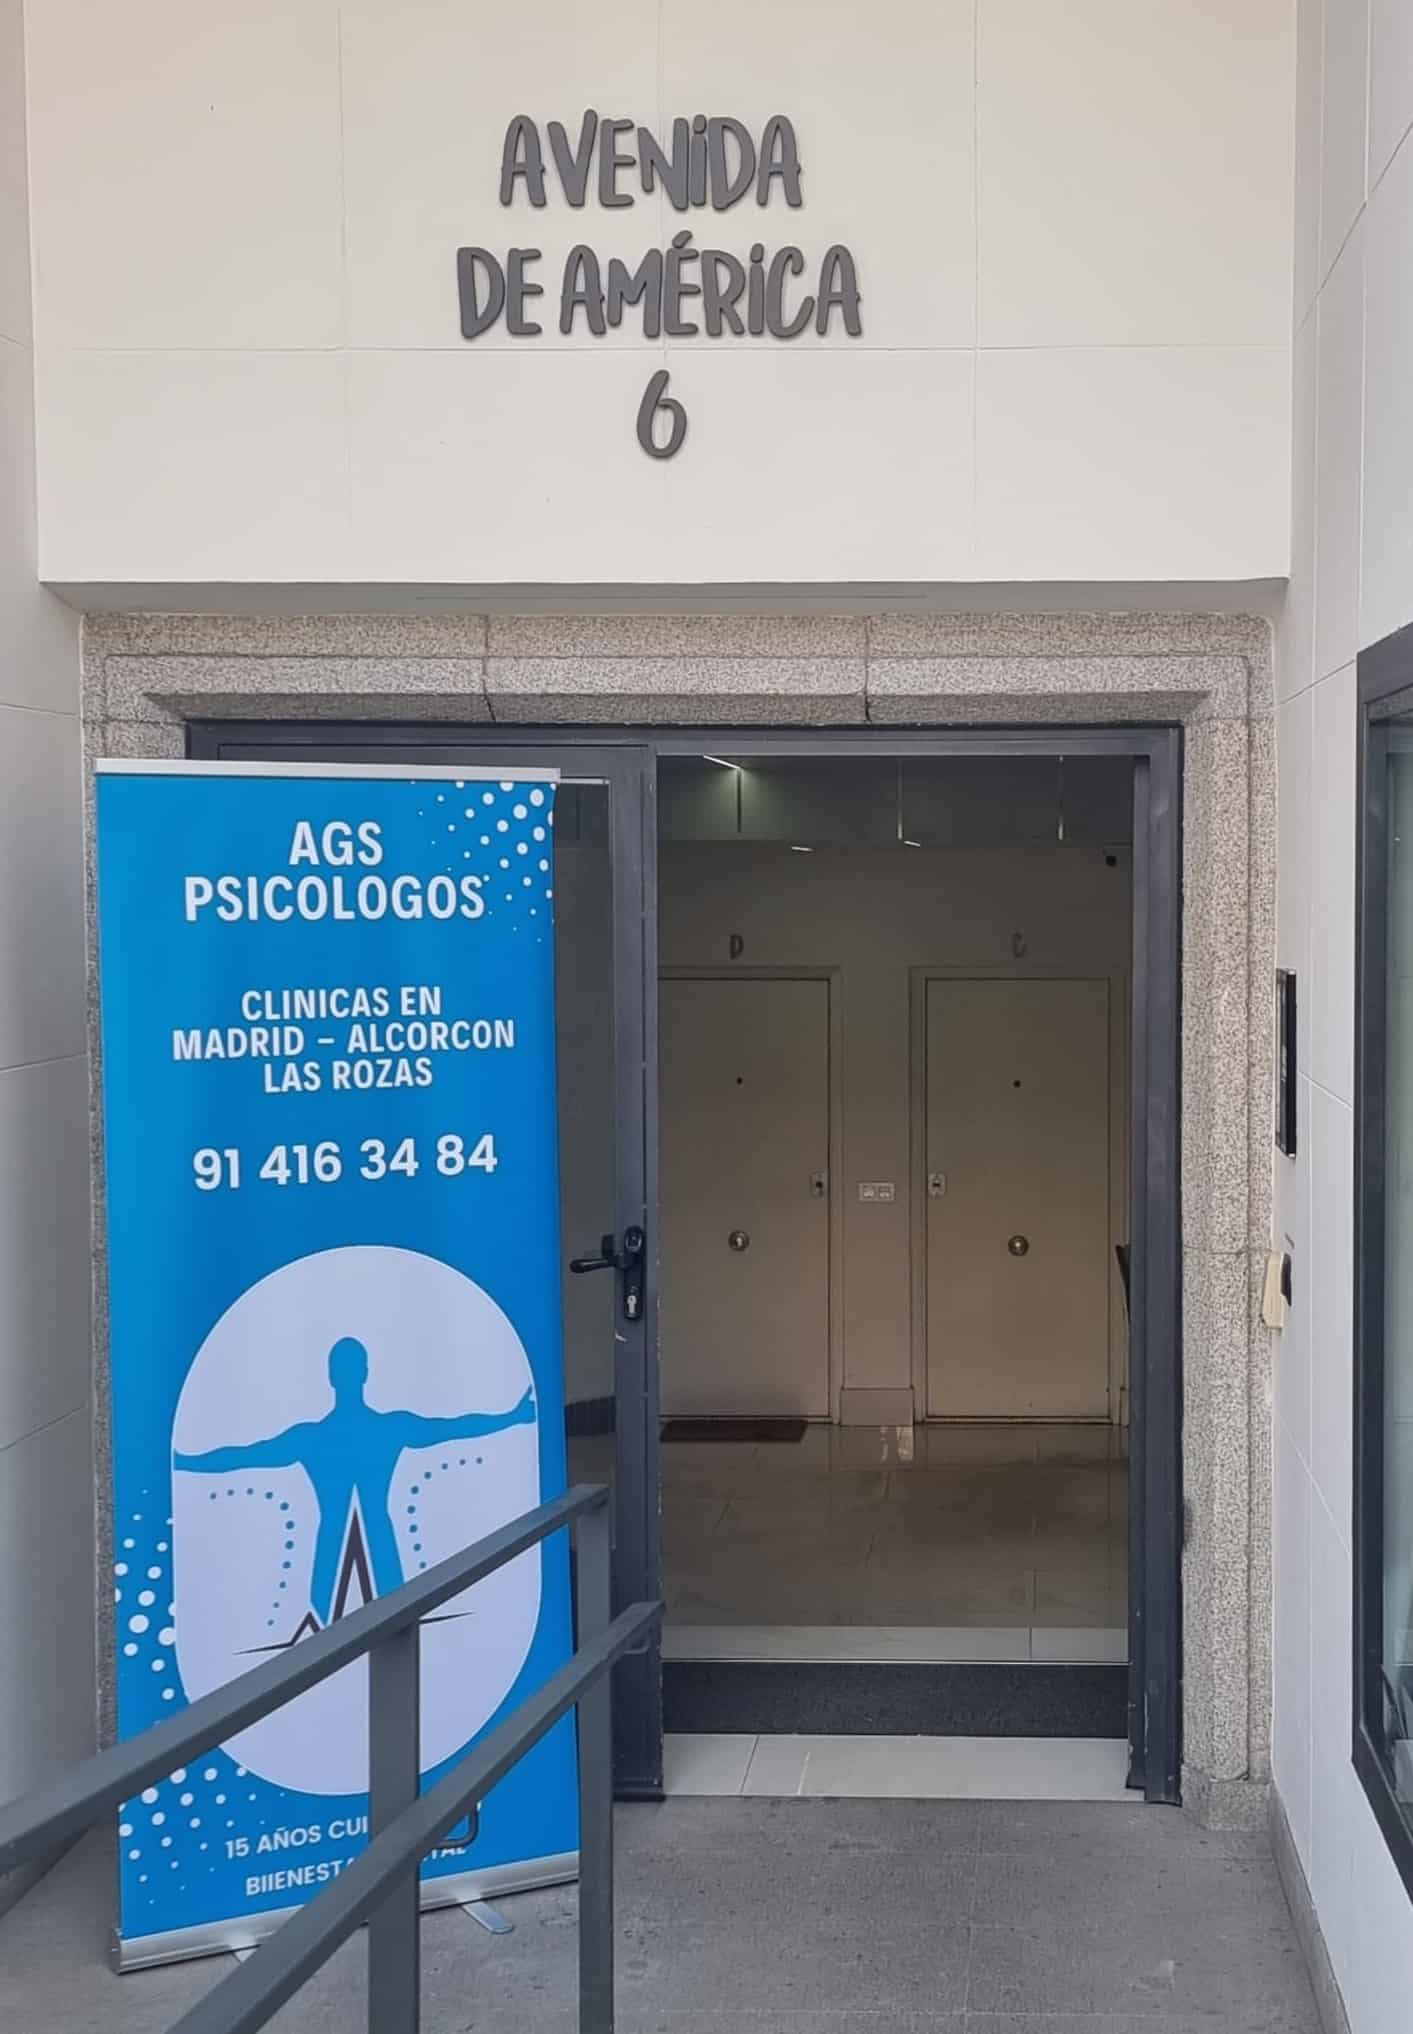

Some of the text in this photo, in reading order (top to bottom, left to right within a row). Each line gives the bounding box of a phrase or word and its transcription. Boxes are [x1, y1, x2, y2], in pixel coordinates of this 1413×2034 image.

[456, 246, 544, 341] DE
[636, 369, 688, 460] 6
[289, 821, 383, 866] AGS
[185, 875, 485, 922] PSICOLOGOS
[241, 986, 441, 1021] CLINICAS EN
[172, 1026, 305, 1061] MADRID
[347, 1019, 515, 1054] ALCORCON
[264, 1057, 433, 1093] LAS ROZAS
[193, 1134, 498, 1190] 91 416 34 84
[225, 1815, 368, 1859] 15 AÑOS CUI
[246, 1857, 354, 1896] BIIENEST
